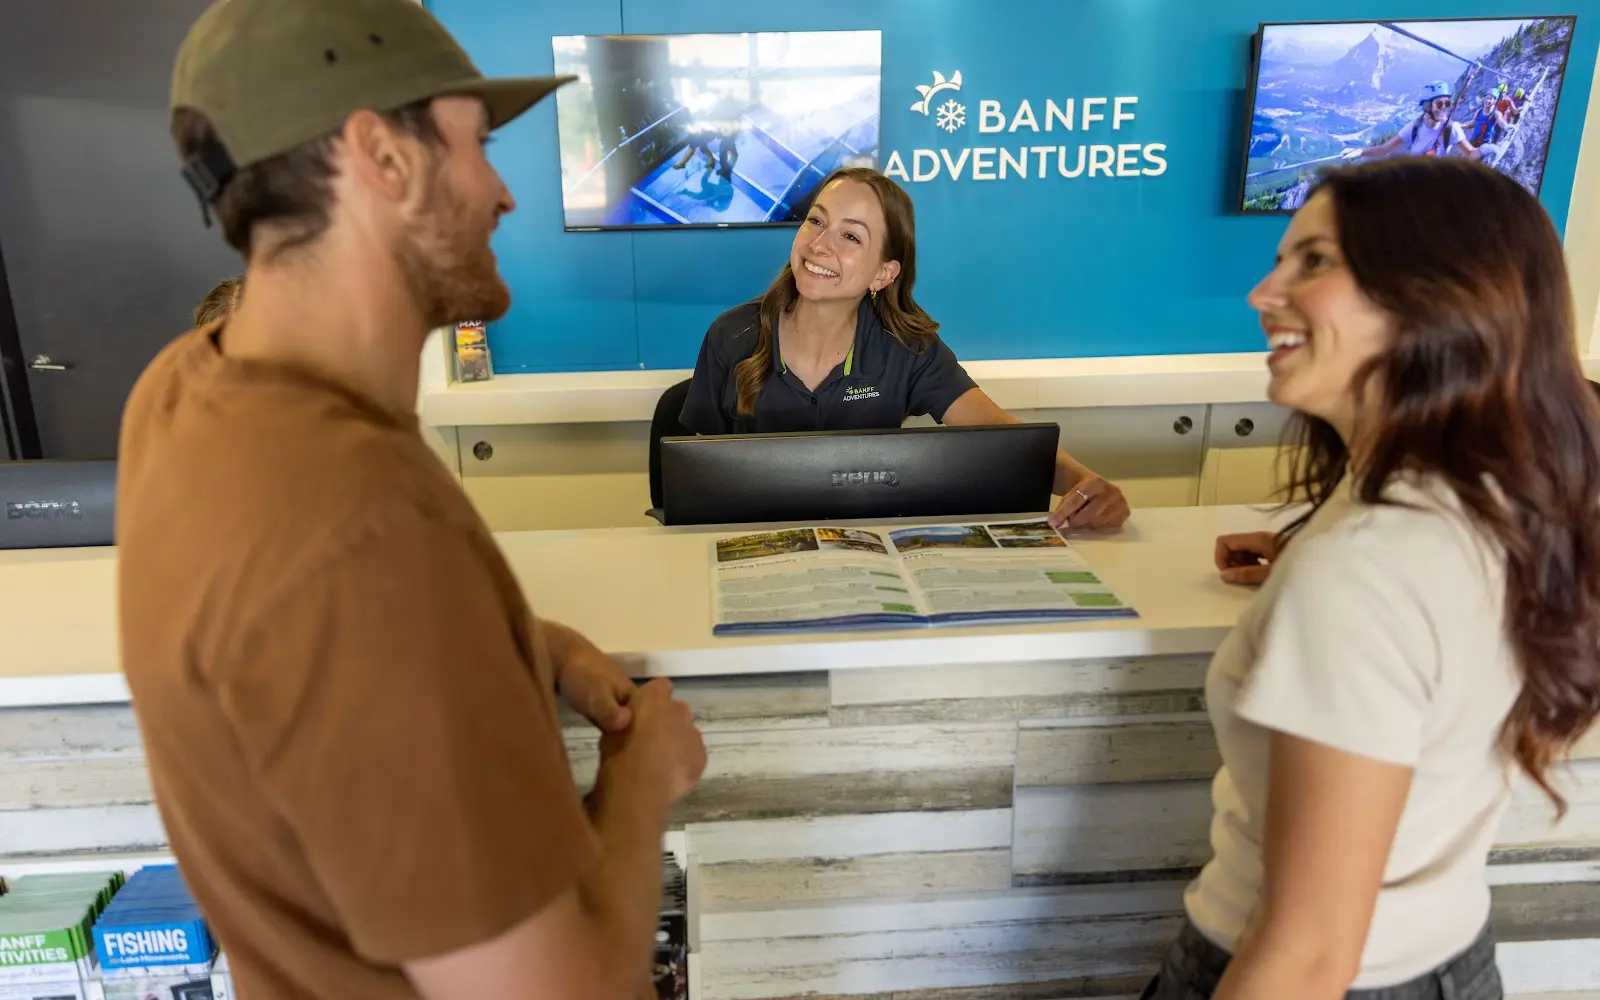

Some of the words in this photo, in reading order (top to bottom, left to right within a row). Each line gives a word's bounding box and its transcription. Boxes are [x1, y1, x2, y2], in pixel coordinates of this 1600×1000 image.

[978, 96, 1138, 133] BANFF
[882, 143, 1168, 182] ADVENTURES
[843, 391, 880, 402] ADVENTURES
[854, 386, 875, 395] BANFF
[103, 928, 188, 956] FISHING
